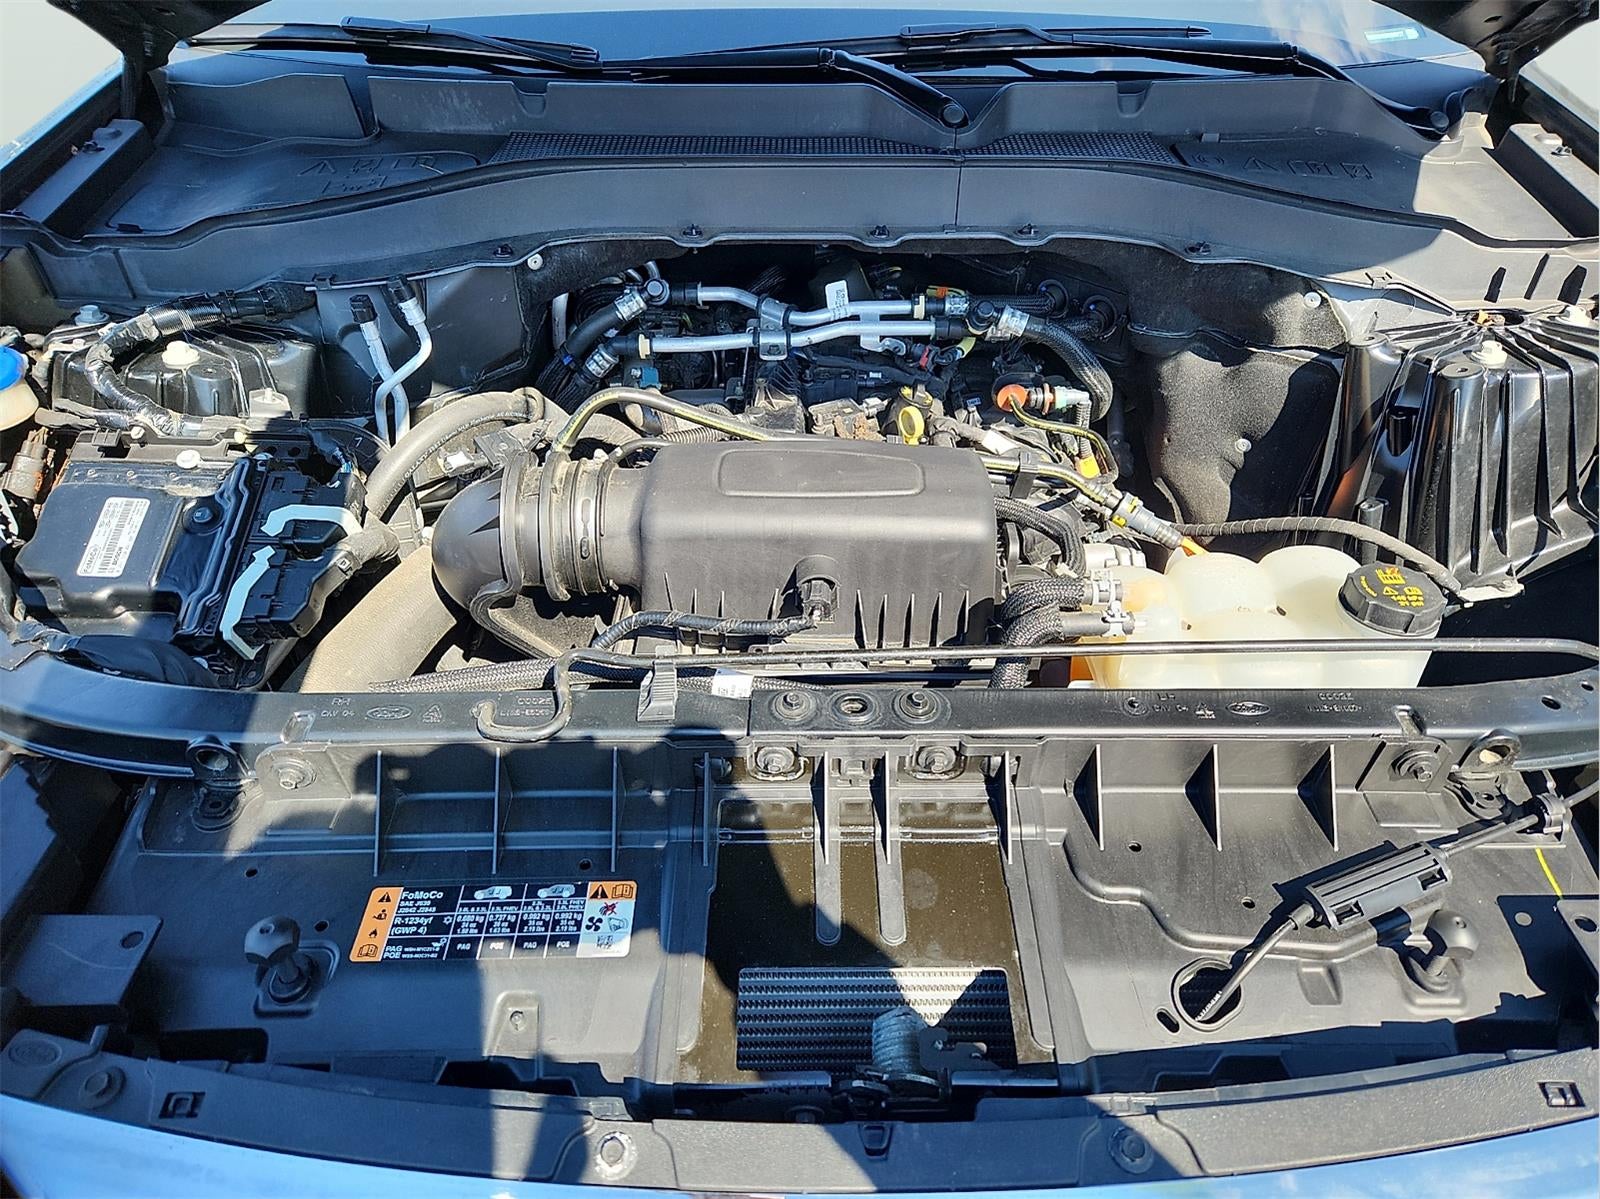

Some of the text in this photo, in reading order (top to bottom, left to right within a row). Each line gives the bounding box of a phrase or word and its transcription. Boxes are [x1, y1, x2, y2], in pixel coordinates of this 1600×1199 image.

[401, 890, 444, 900] FoMoCo
[394, 916, 433, 925] R-1234yf
[475, 914, 485, 923] kg
[507, 914, 516, 922] kg
[541, 913, 551, 921] kg
[391, 926, 427, 935] (GWP 4)
[489, 942, 504, 950] POE
